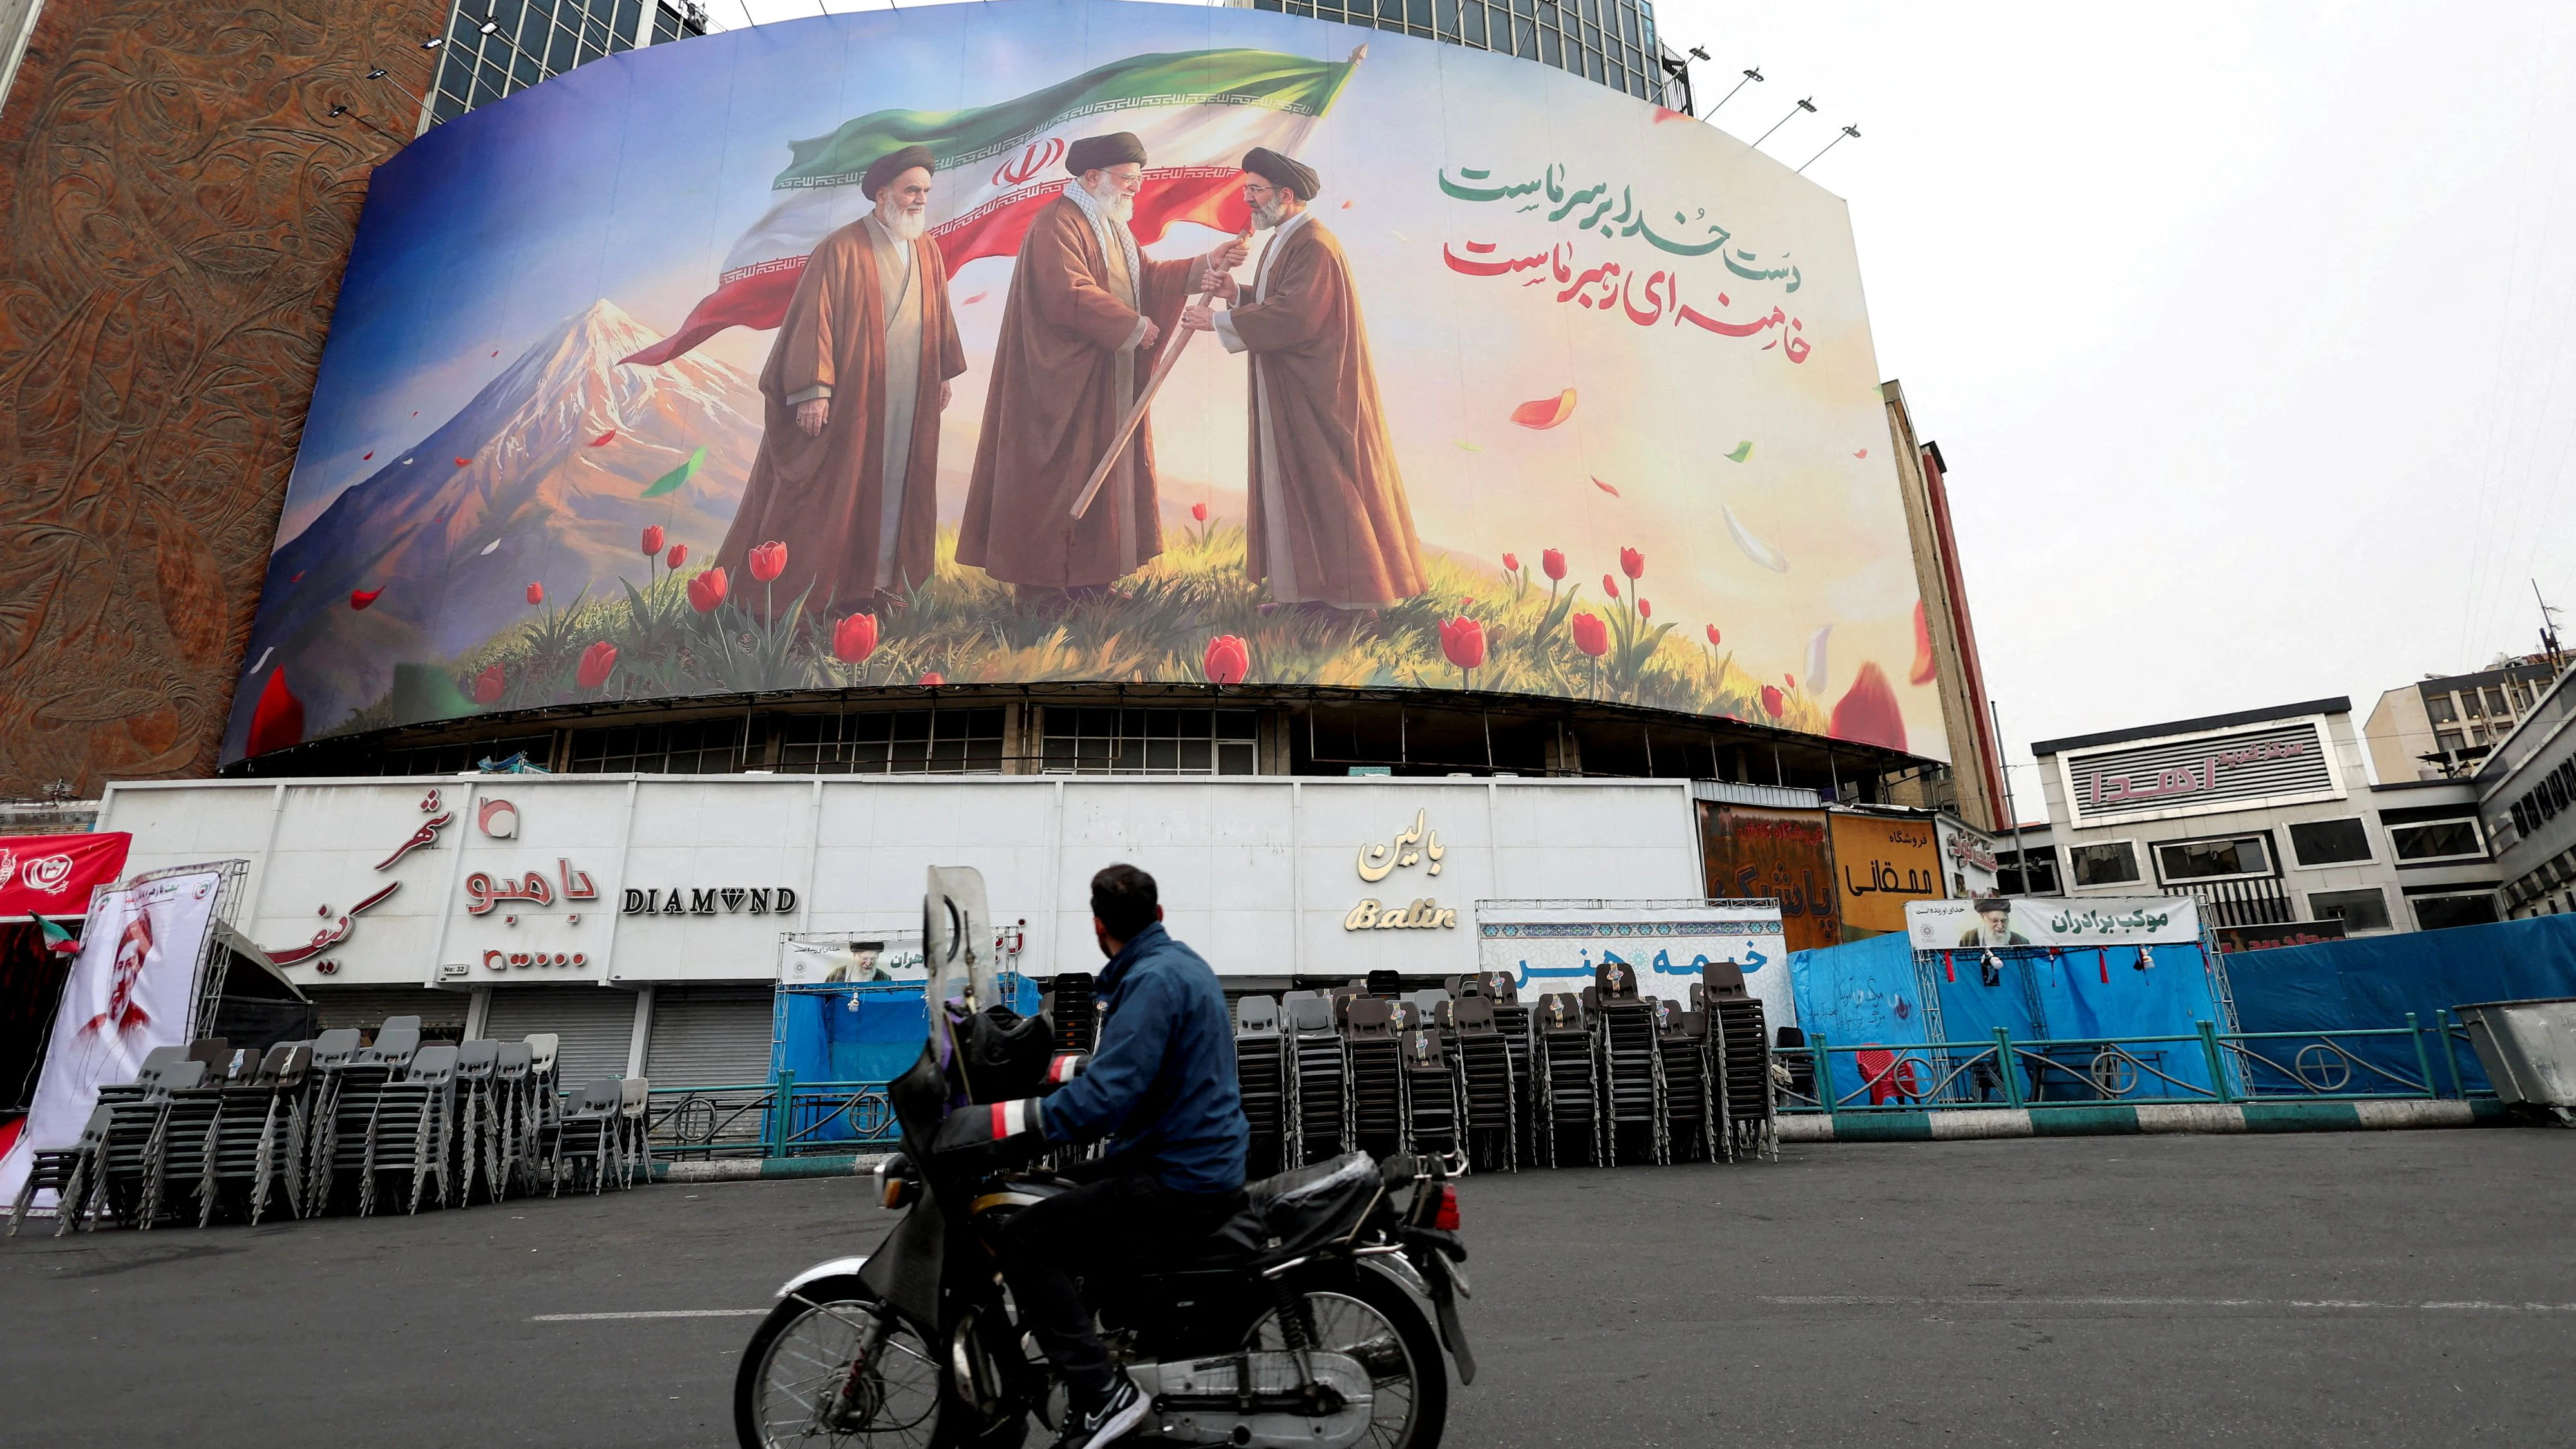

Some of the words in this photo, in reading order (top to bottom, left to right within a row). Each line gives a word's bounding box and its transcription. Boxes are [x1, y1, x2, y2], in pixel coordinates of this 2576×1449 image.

[1548, 182, 1606, 222] سر
[1579, 197, 1613, 238] بر
[2217, 743, 2259, 768] خرید
[2263, 742, 2303, 761] مرکز
[2090, 757, 2215, 804] اهدا
[373, 788, 453, 871] شهر
[1357, 808, 1445, 882] بالین
[1889, 830, 1927, 848] فروشگاه
[464, 858, 599, 925] بامبو
[622, 887, 797, 913] DIAMND
[1345, 898, 1457, 931] Balin
[2052, 909, 2115, 934] برادران
[2116, 909, 2168, 933] موکب
